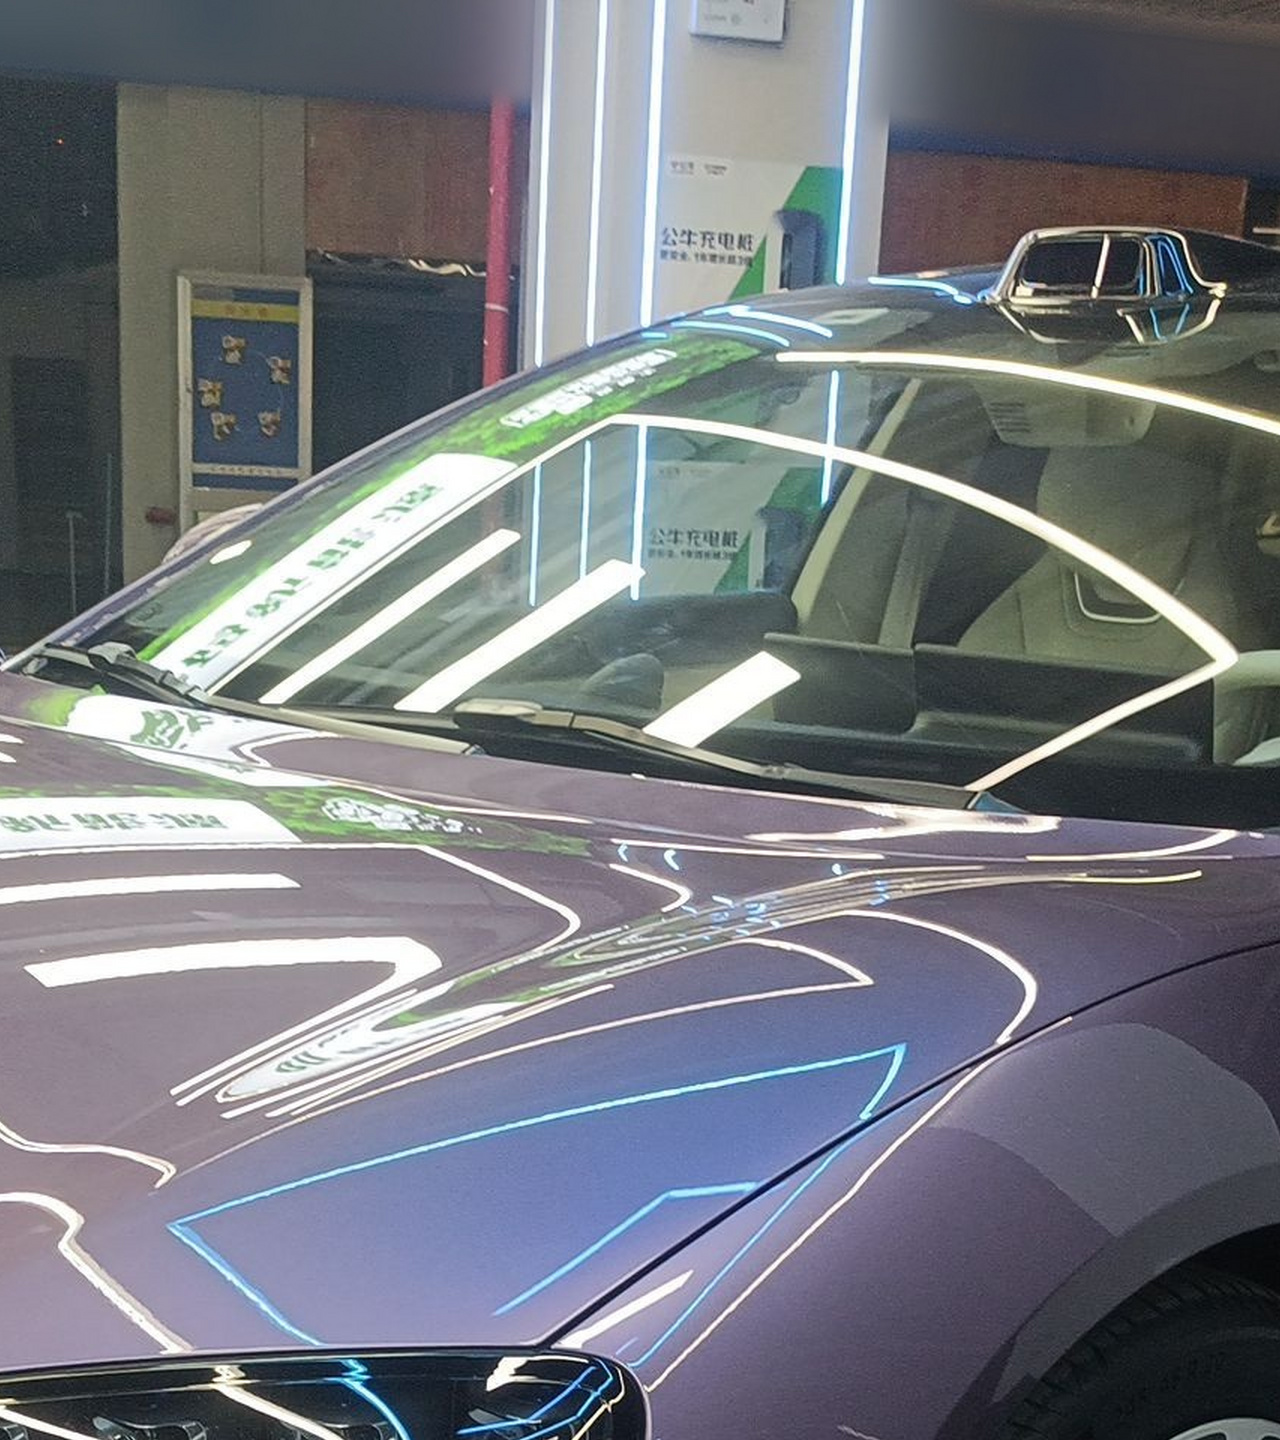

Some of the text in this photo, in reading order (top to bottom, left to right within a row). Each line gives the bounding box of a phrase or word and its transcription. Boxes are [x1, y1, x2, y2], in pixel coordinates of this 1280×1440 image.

[661, 228, 754, 251] 公牛充电桩
